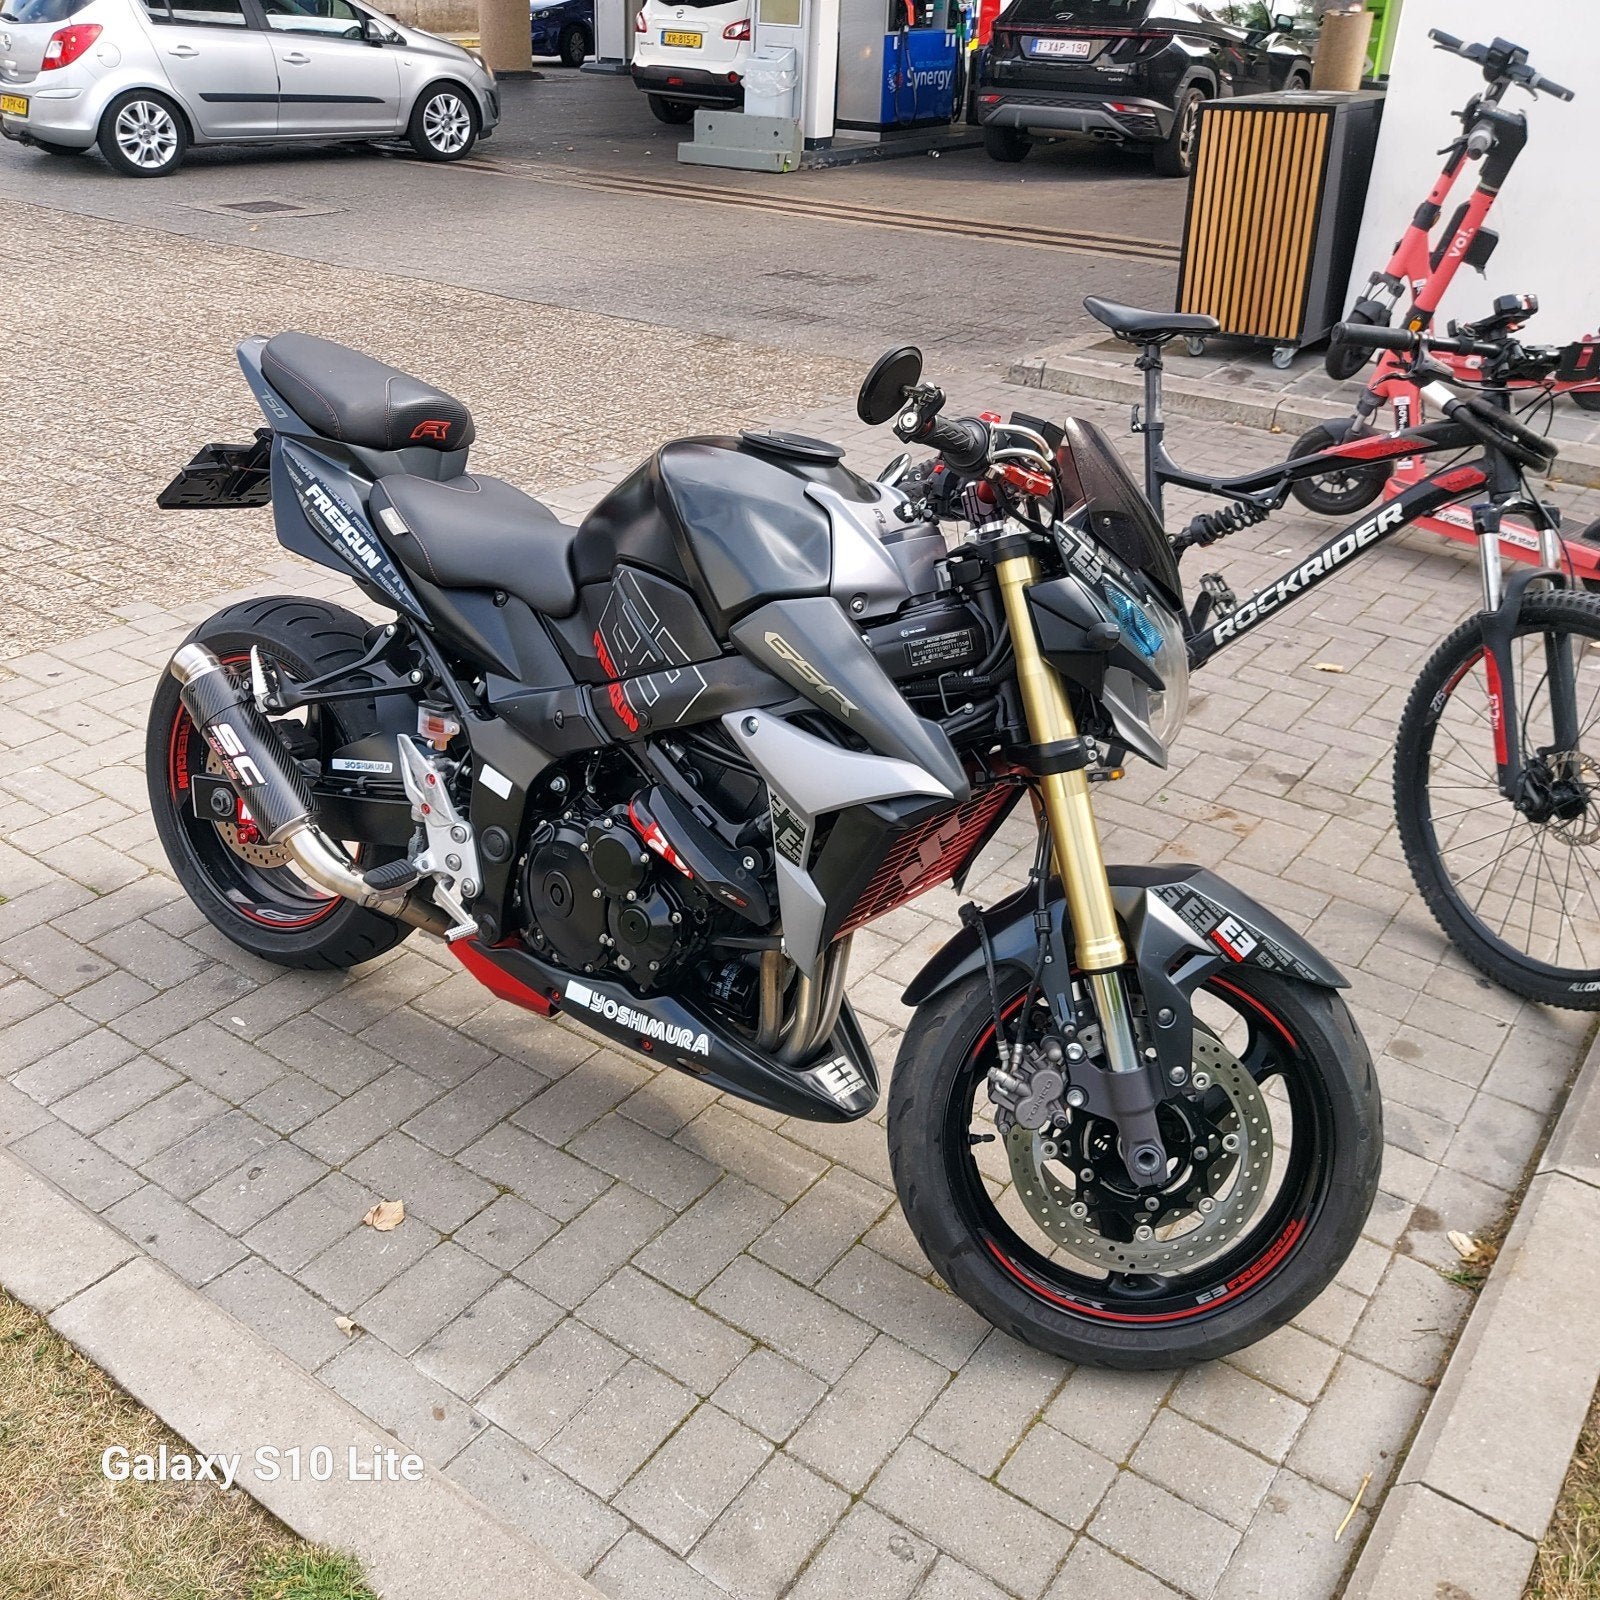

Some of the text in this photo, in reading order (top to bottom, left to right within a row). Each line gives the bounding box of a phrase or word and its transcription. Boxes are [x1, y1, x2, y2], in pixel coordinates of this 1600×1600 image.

[1038, 41, 1088, 54] T-XAP-190
[906, 66, 953, 90] Synergy
[261, 388, 289, 419] 750
[1212, 502, 1405, 646] ROCKRIDER
[764, 631, 860, 718] GSR
[344, 761, 391, 772] YOSHIMURA
[590, 991, 710, 1057] YOSHIMURA
